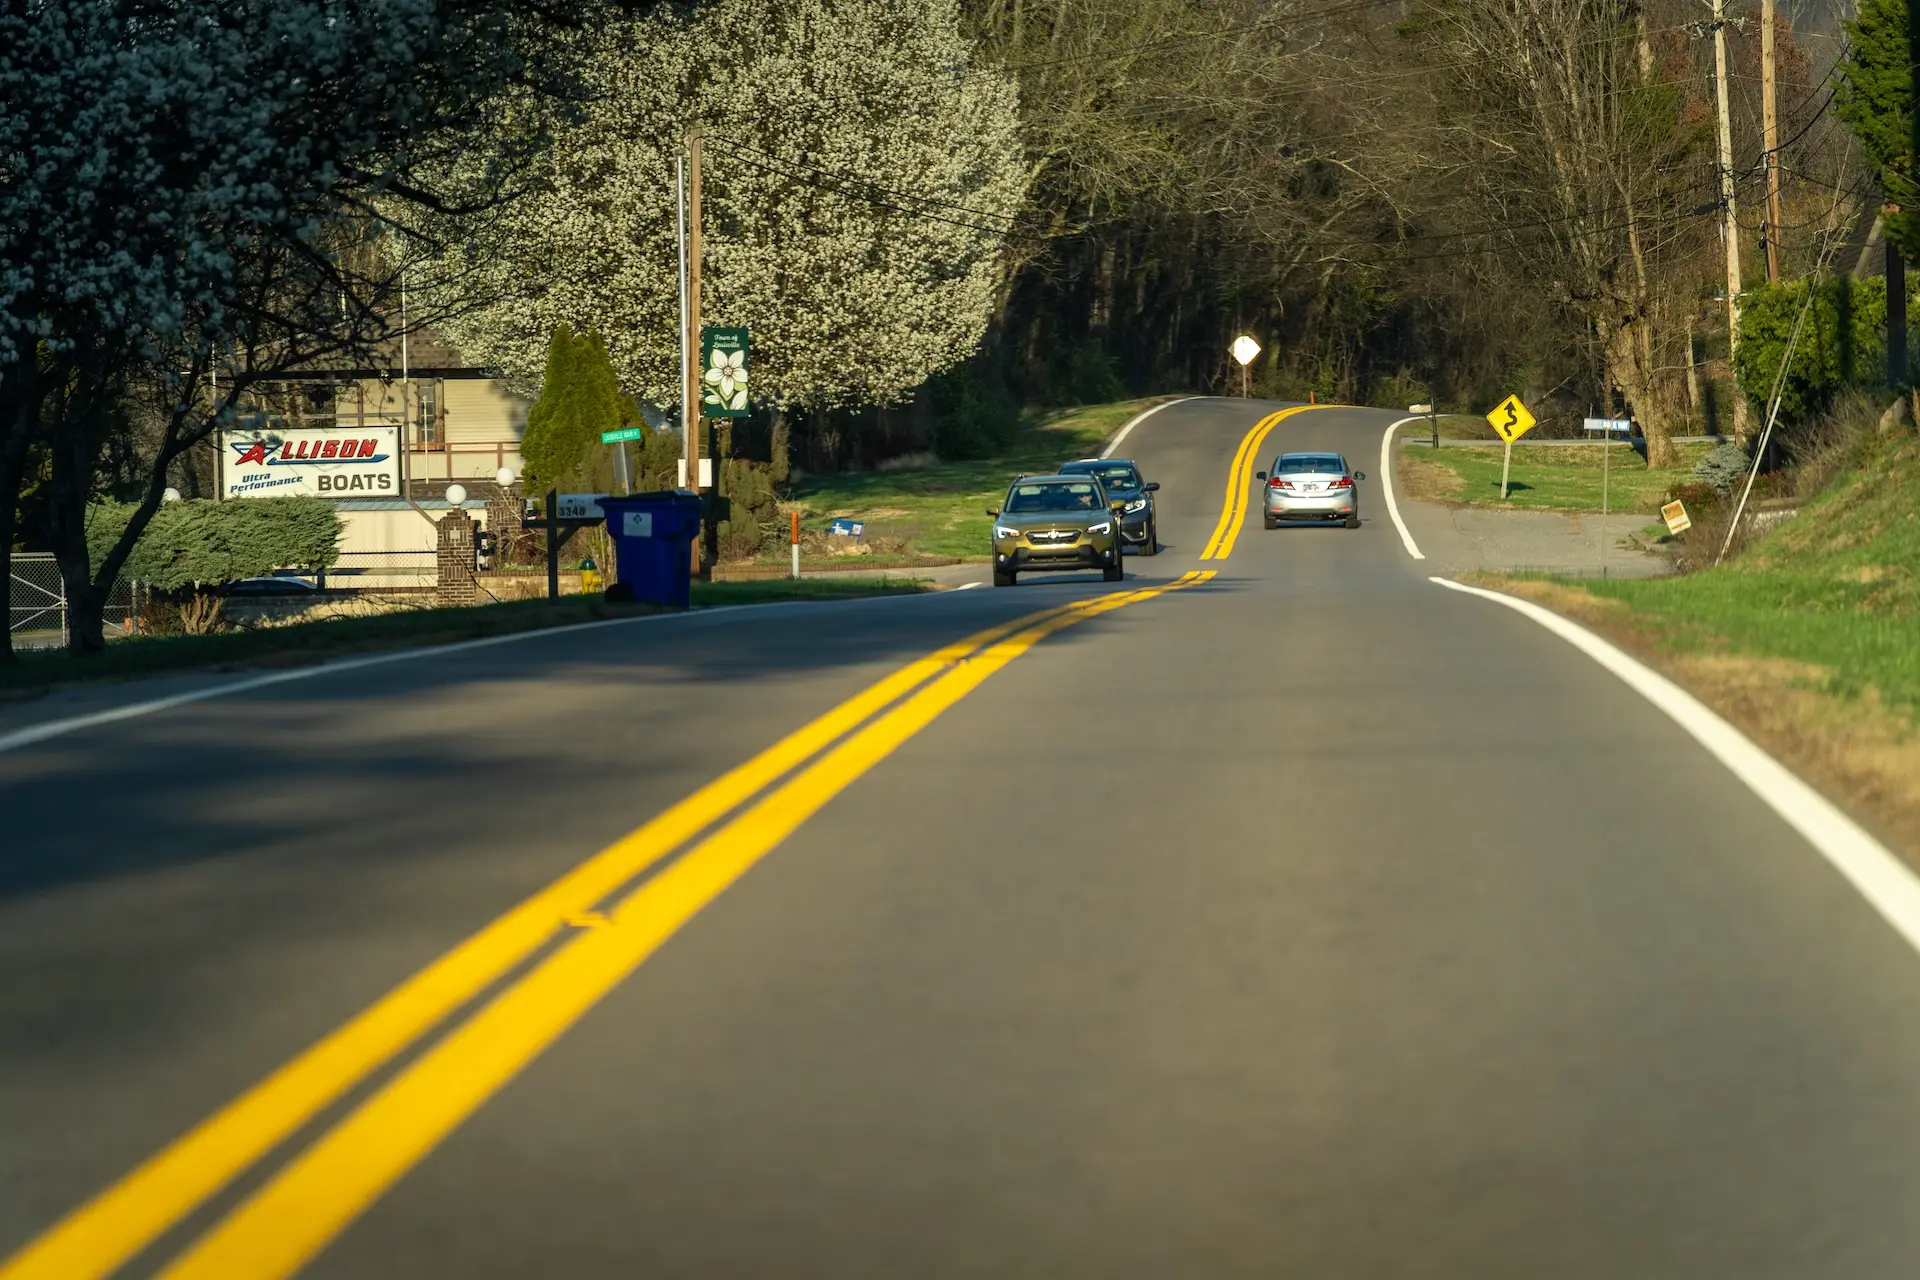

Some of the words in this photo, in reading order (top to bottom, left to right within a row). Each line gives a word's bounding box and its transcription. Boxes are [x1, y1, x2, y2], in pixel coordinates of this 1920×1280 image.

[234, 439, 378, 466] ALLISON
[230, 475, 303, 493] Performance
[242, 472, 271, 483] Ultra
[318, 473, 391, 491] BOATS
